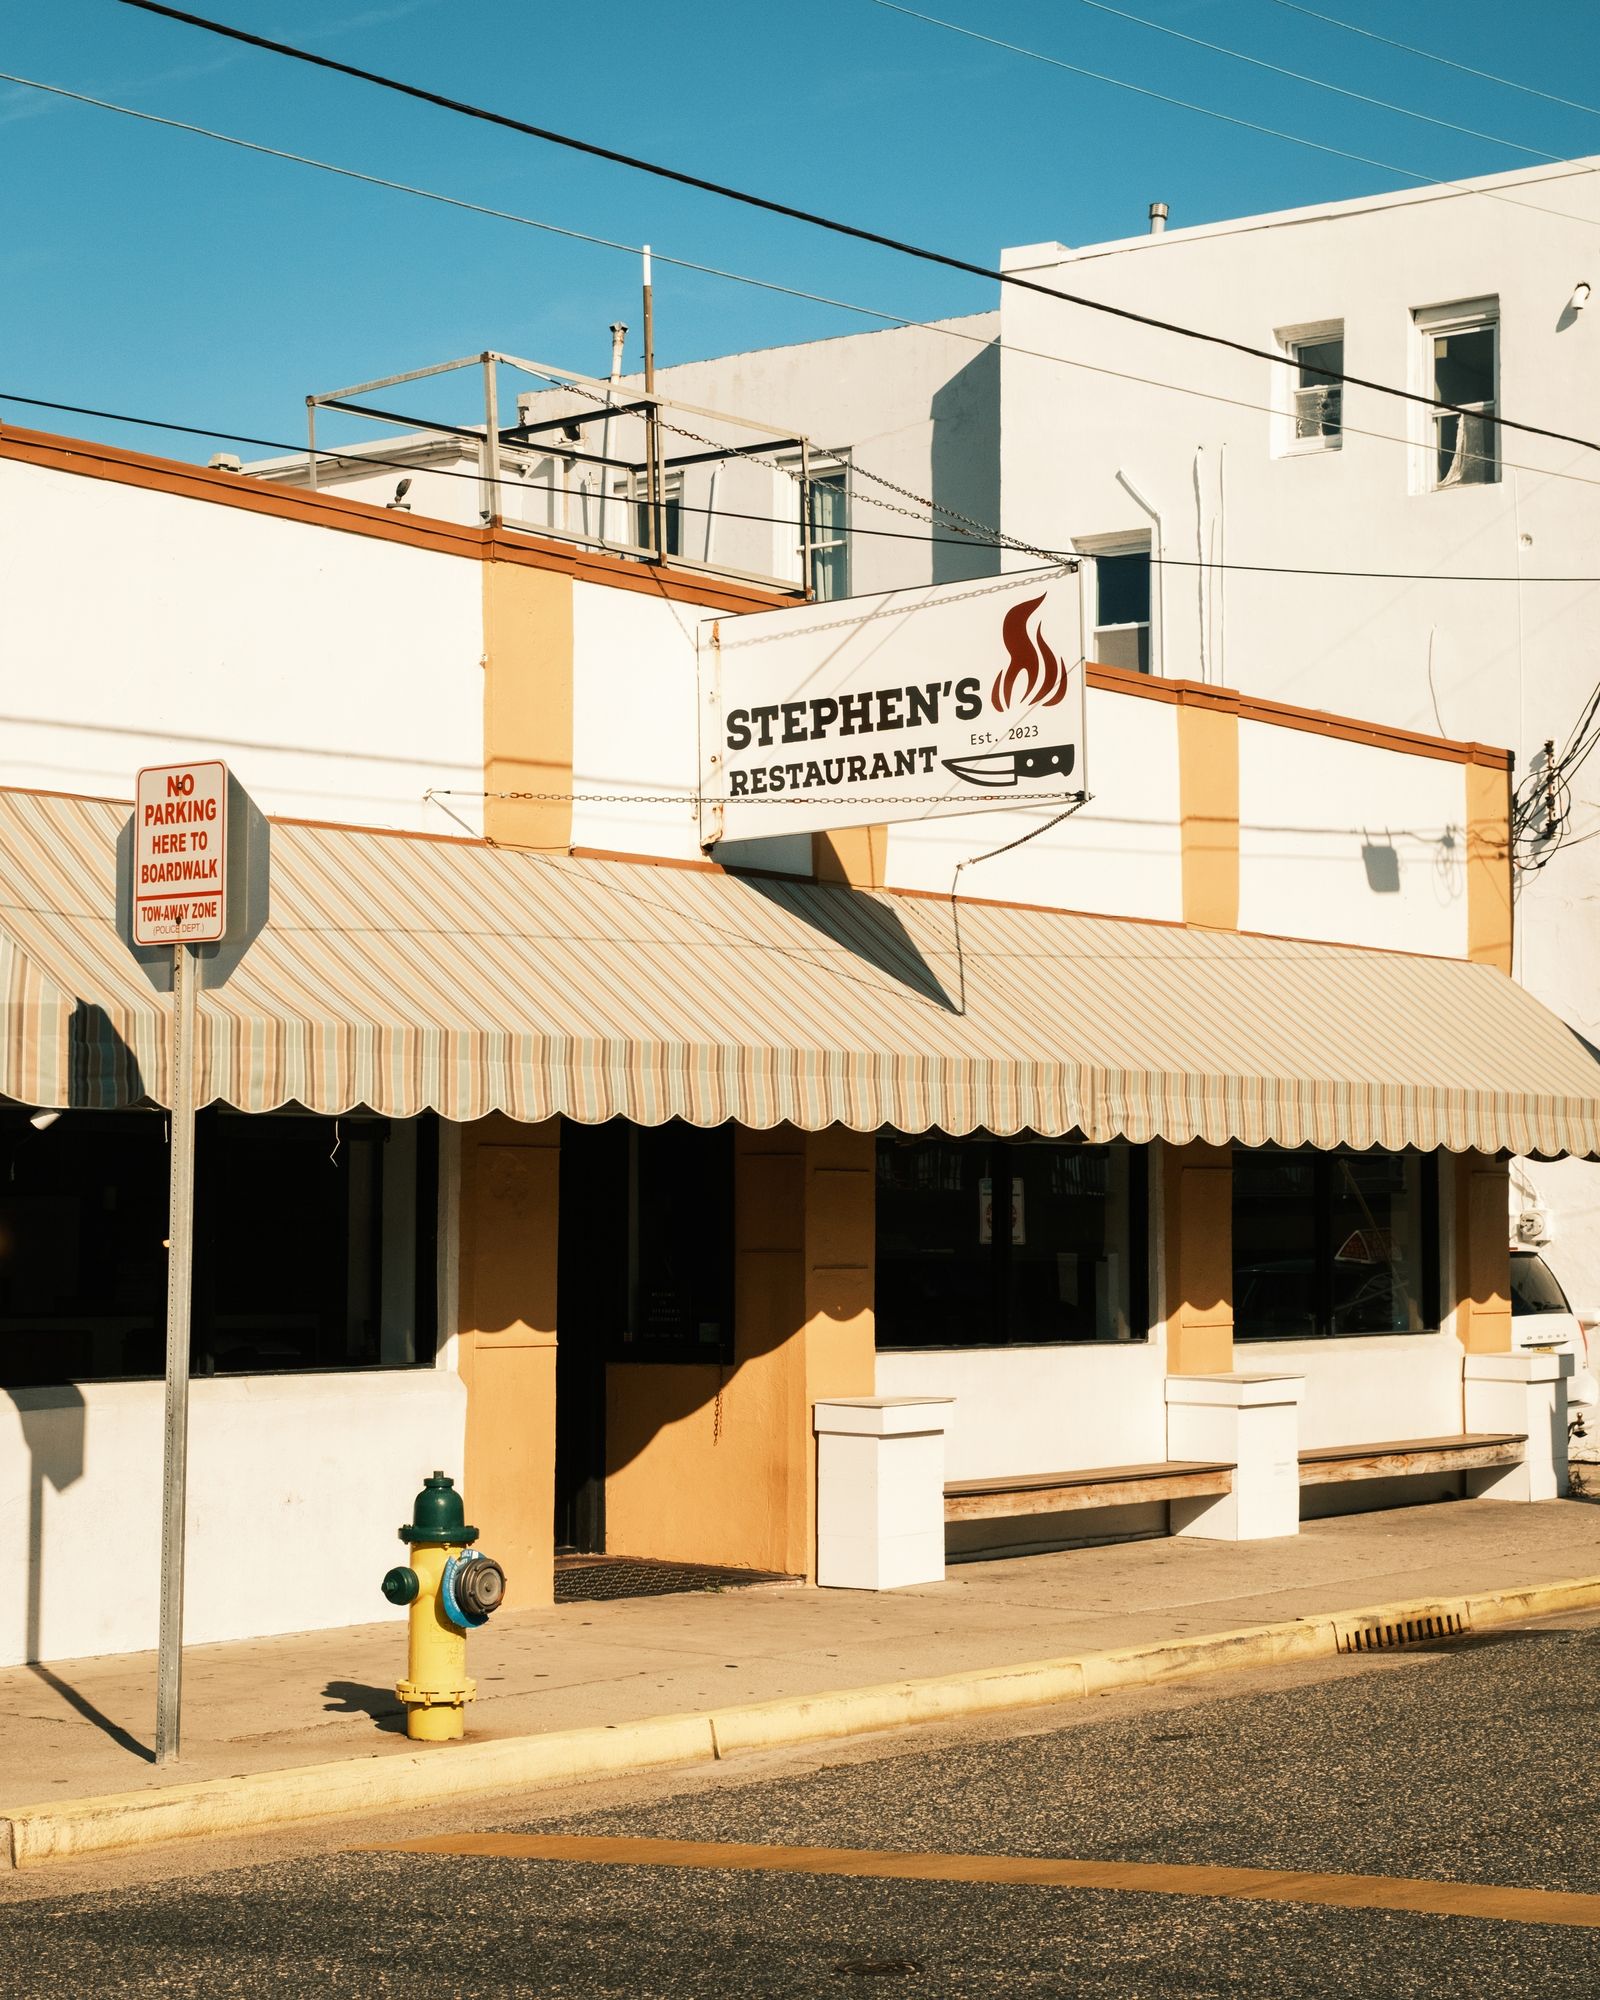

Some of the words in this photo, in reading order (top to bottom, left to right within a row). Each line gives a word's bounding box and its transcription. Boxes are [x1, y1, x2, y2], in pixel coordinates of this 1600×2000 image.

[727, 677, 983, 751] STEPHEN'S
[970, 732, 998, 745] Est.
[1008, 725, 1039, 740] 2023
[729, 745, 938, 797] RESTAURANT
[167, 773, 194, 797] NO
[144, 798, 216, 827] PARKING
[152, 833, 186, 854] HERE
[190, 831, 208, 851] TO
[141, 858, 218, 884] BOARDWALK
[141, 904, 190, 922] TOW-AWAY
[191, 901, 217, 919] ZONE
